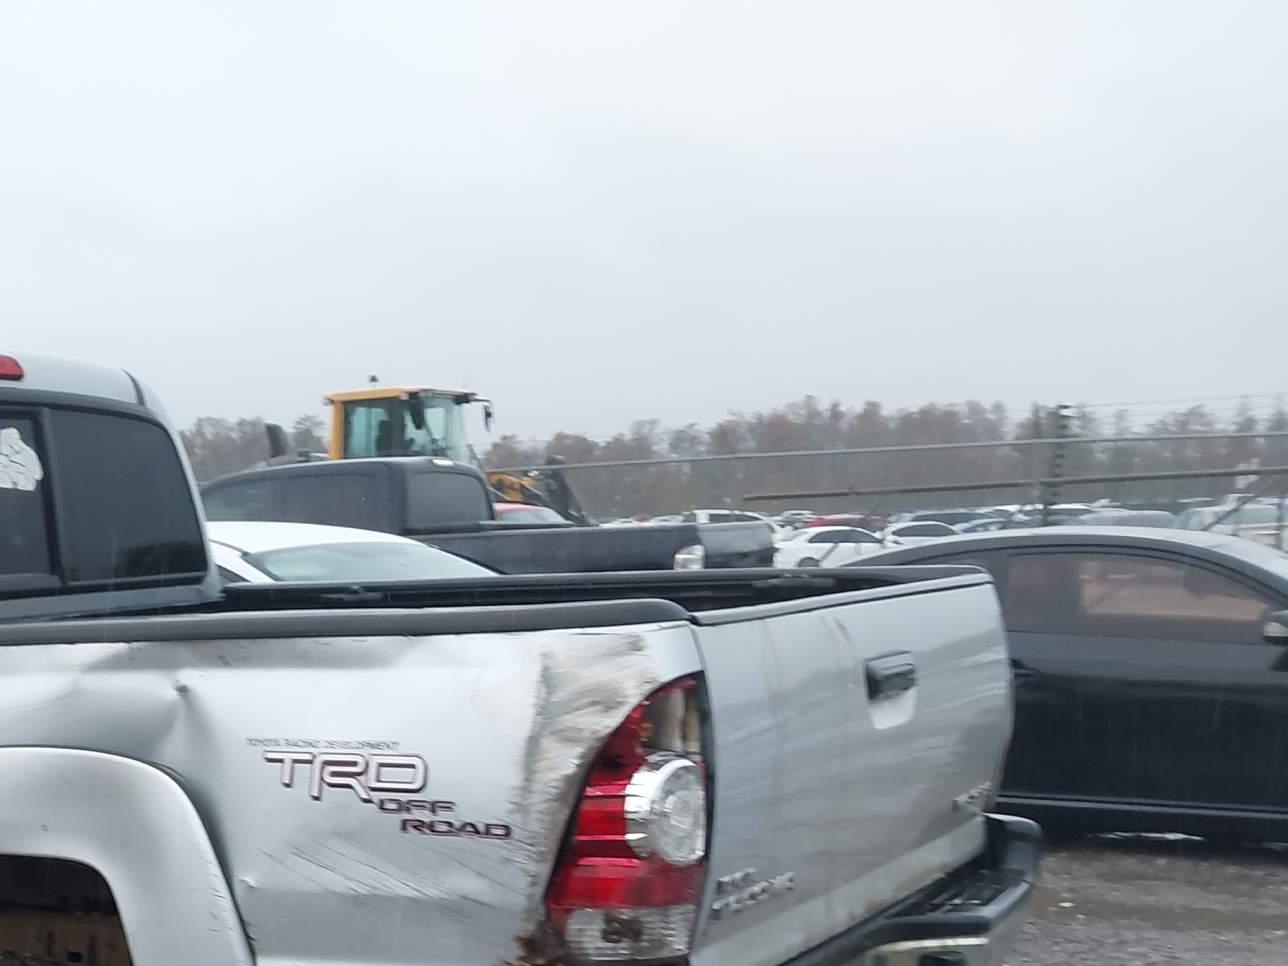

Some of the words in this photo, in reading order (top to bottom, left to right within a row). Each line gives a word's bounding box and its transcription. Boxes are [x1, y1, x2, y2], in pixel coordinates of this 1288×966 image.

[263, 749, 429, 804] TRD
[377, 798, 457, 816] OFF
[401, 818, 513, 840] ROAD
